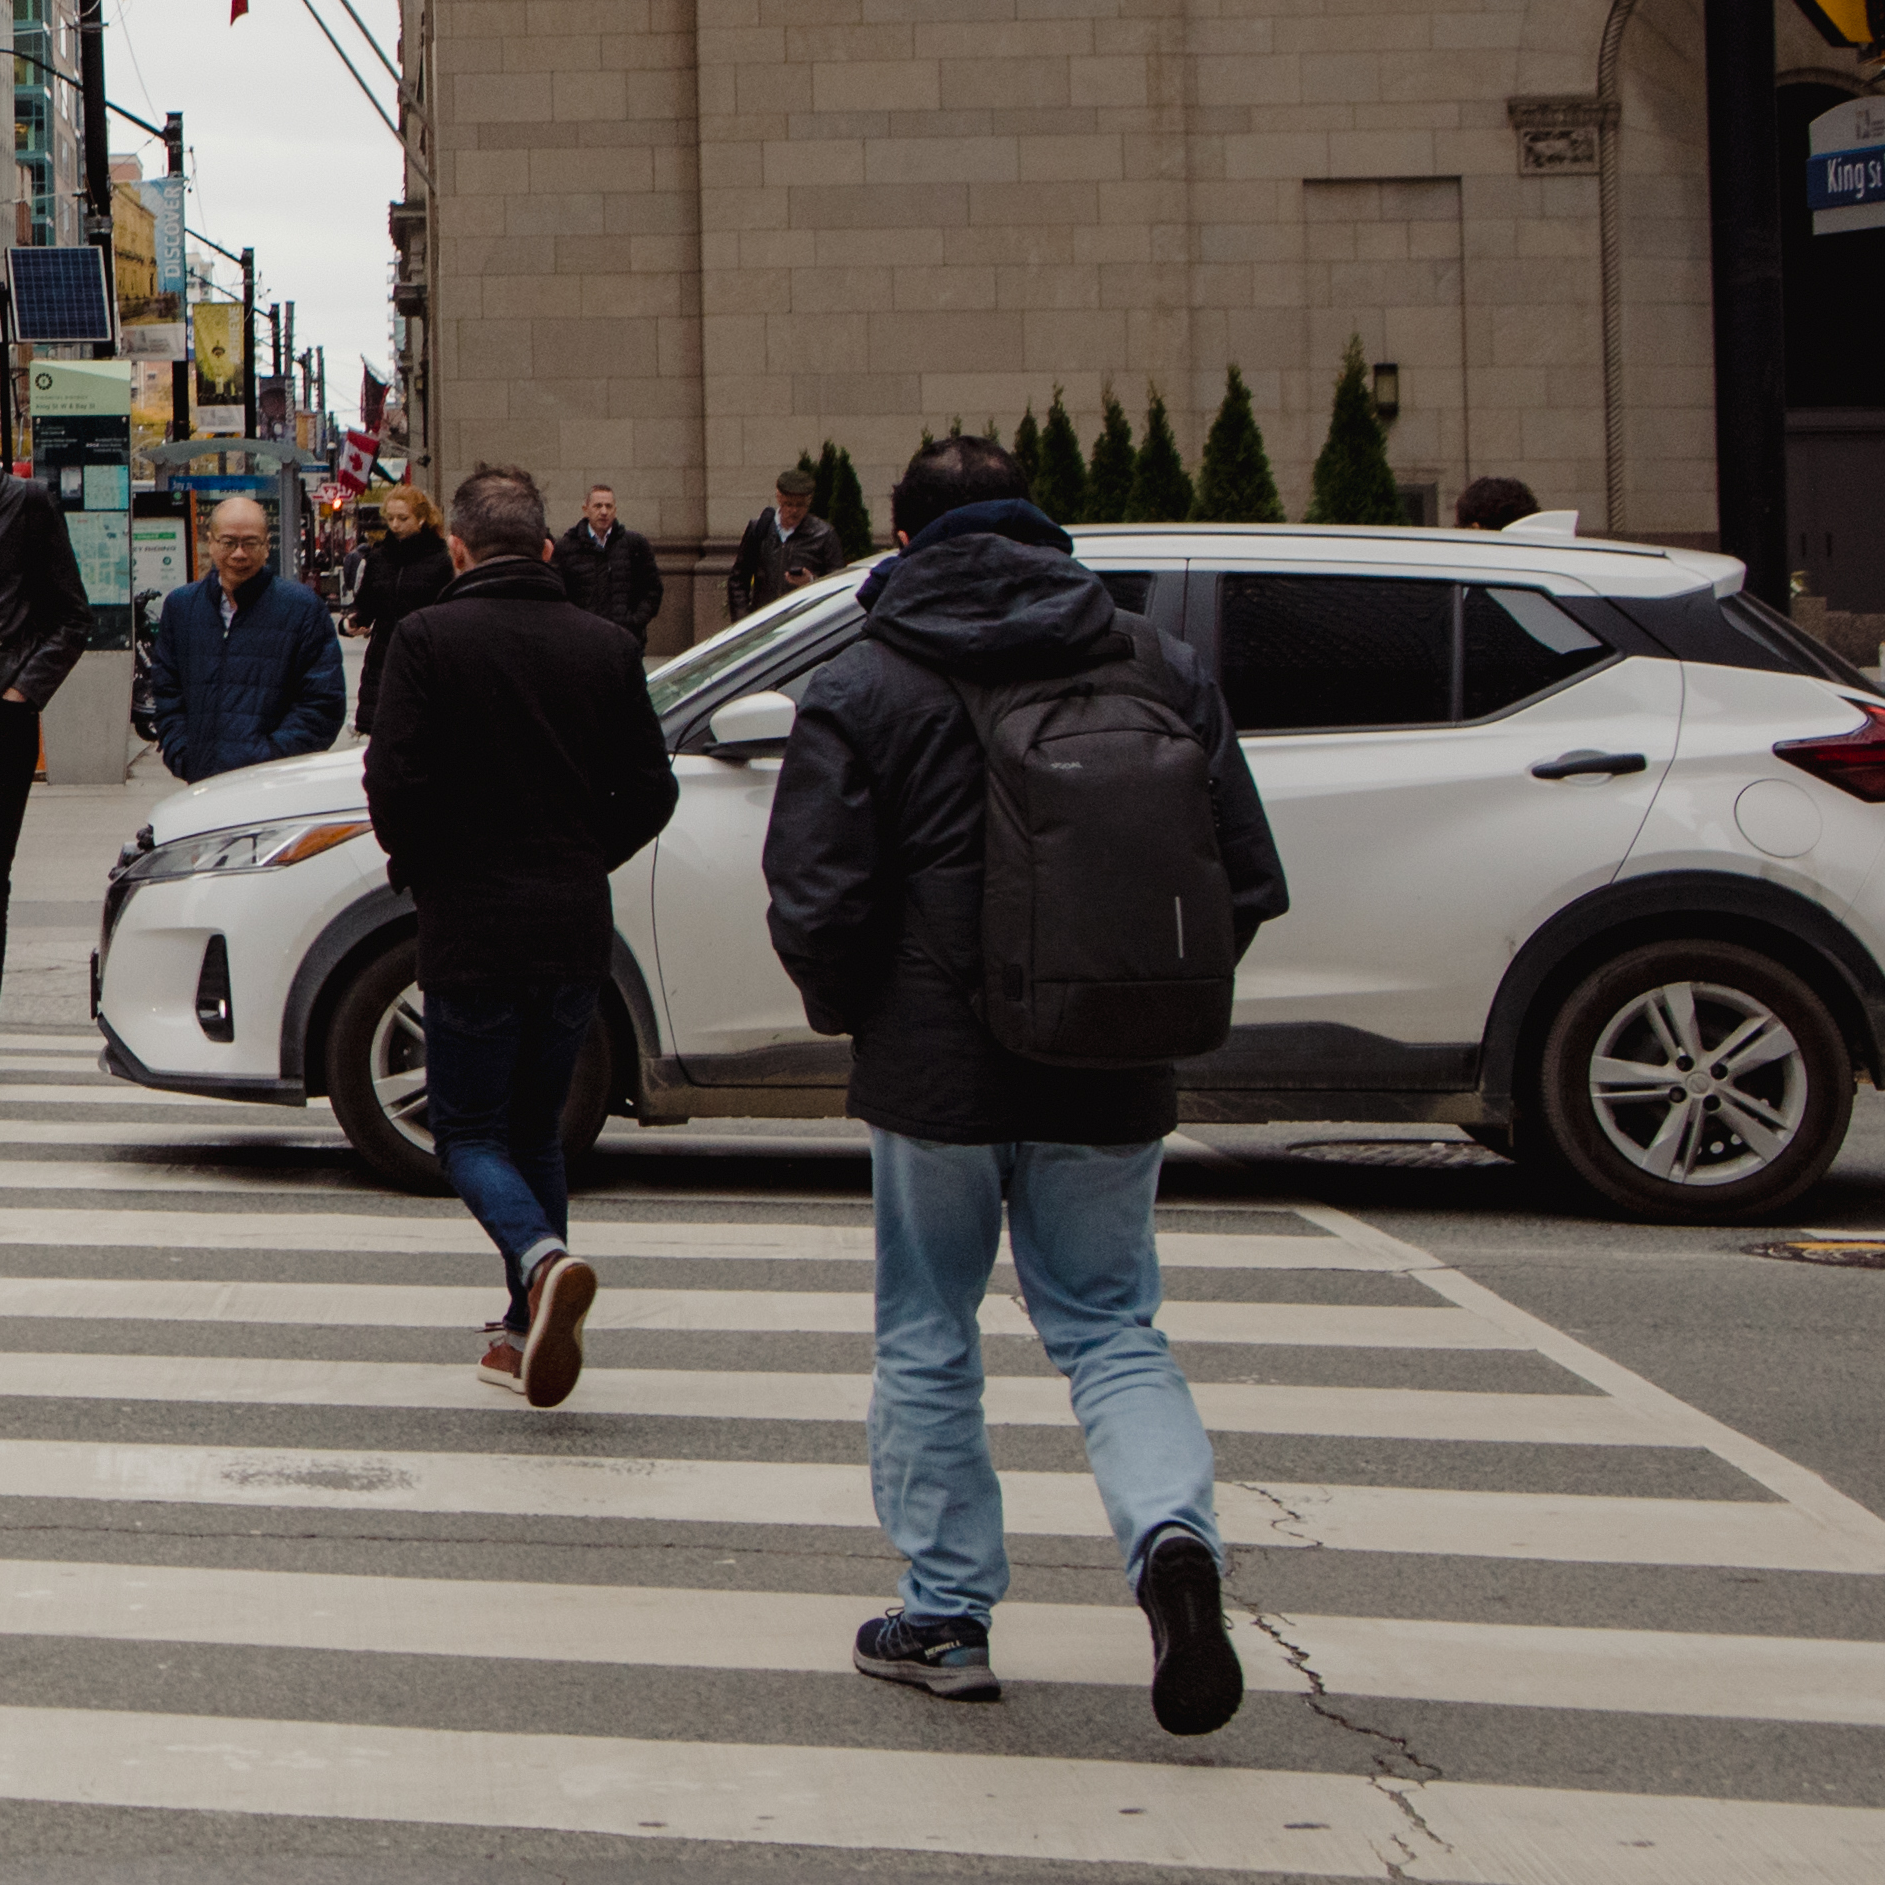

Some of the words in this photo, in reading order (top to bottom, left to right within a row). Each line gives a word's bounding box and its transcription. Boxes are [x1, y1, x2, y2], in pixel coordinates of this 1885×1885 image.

[1827, 157, 1865, 199] King
[1868, 160, 1883, 189] St
[164, 185, 181, 279] DISCOVER
